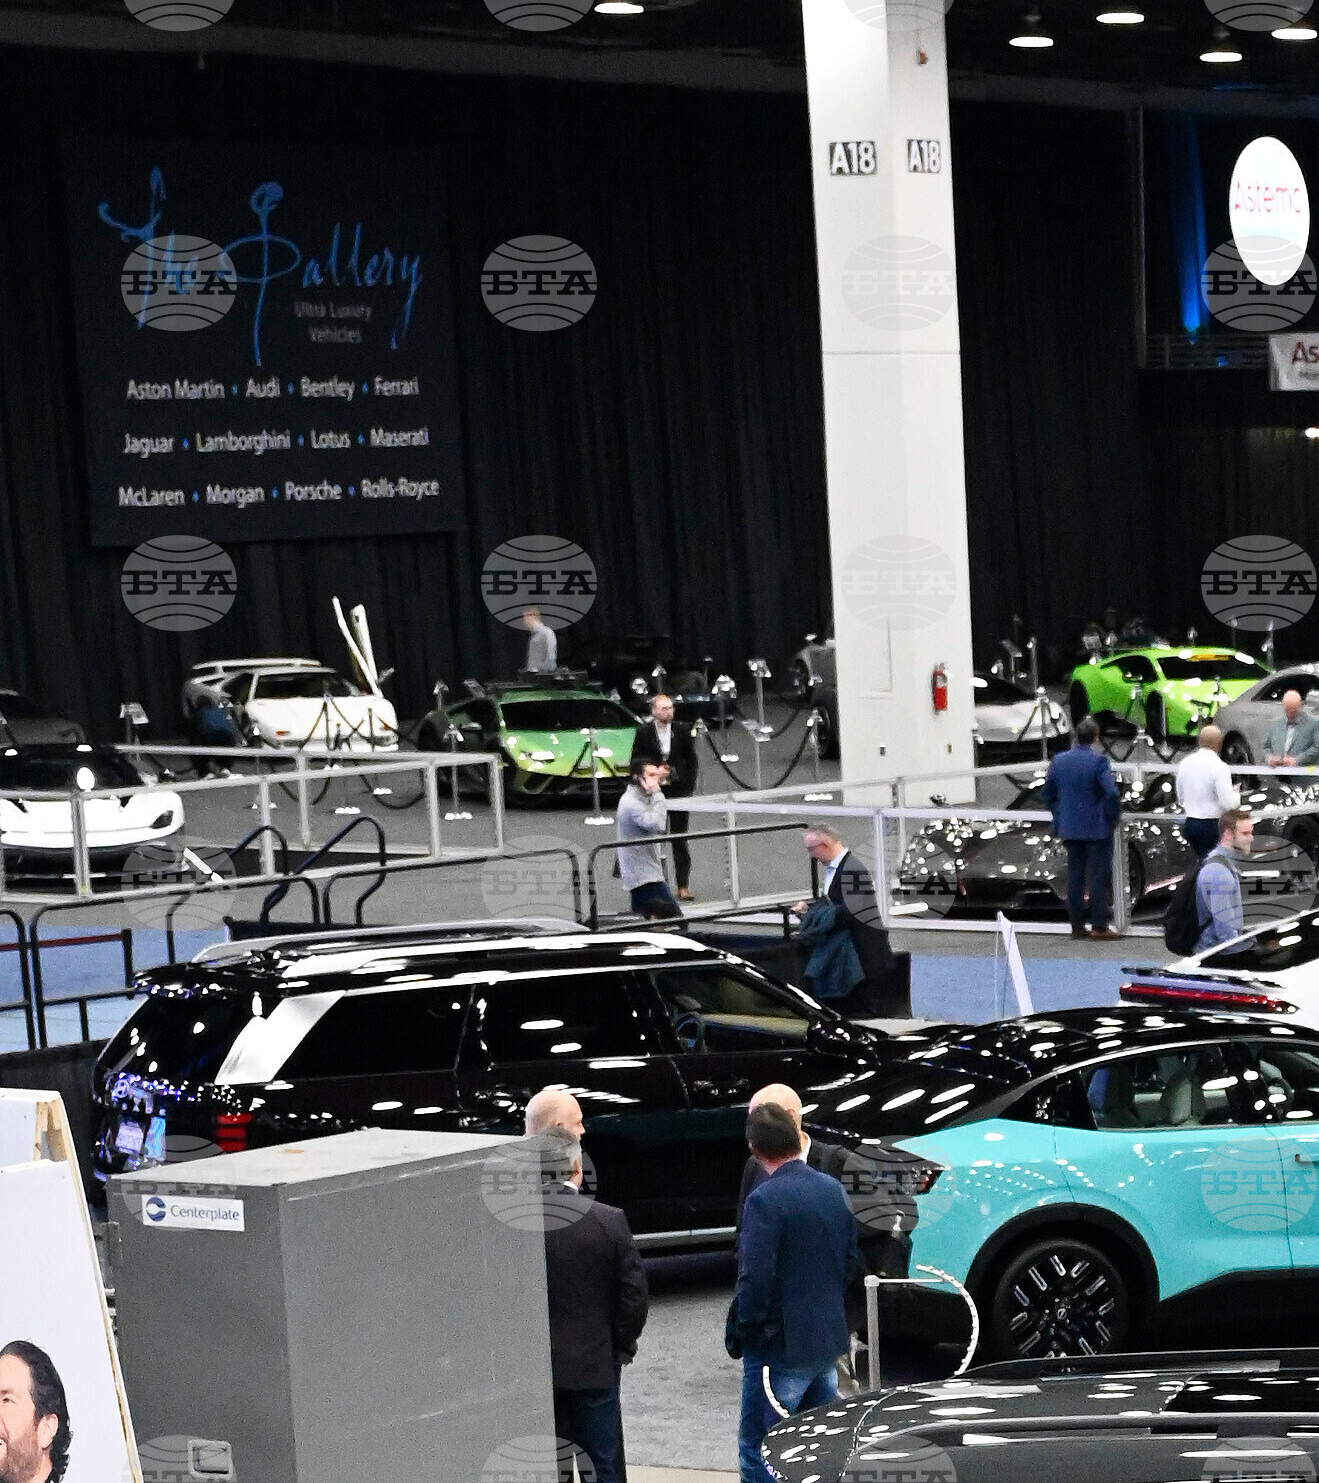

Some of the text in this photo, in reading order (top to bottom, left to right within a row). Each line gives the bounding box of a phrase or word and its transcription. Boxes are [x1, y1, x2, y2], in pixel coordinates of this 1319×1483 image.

[831, 141, 876, 174] A18
[908, 140, 941, 173] A18
[1234, 180, 1303, 214] Astemo
[126, 376, 419, 402] Aston Martin Audi Bentley Ferrari
[124, 427, 429, 459] Jaguar Lamborghini Lotus Maserati
[118, 477, 439, 509] McLaren Morgan Porsche Rolls-Royce
[171, 1204, 240, 1221] Centerplate
